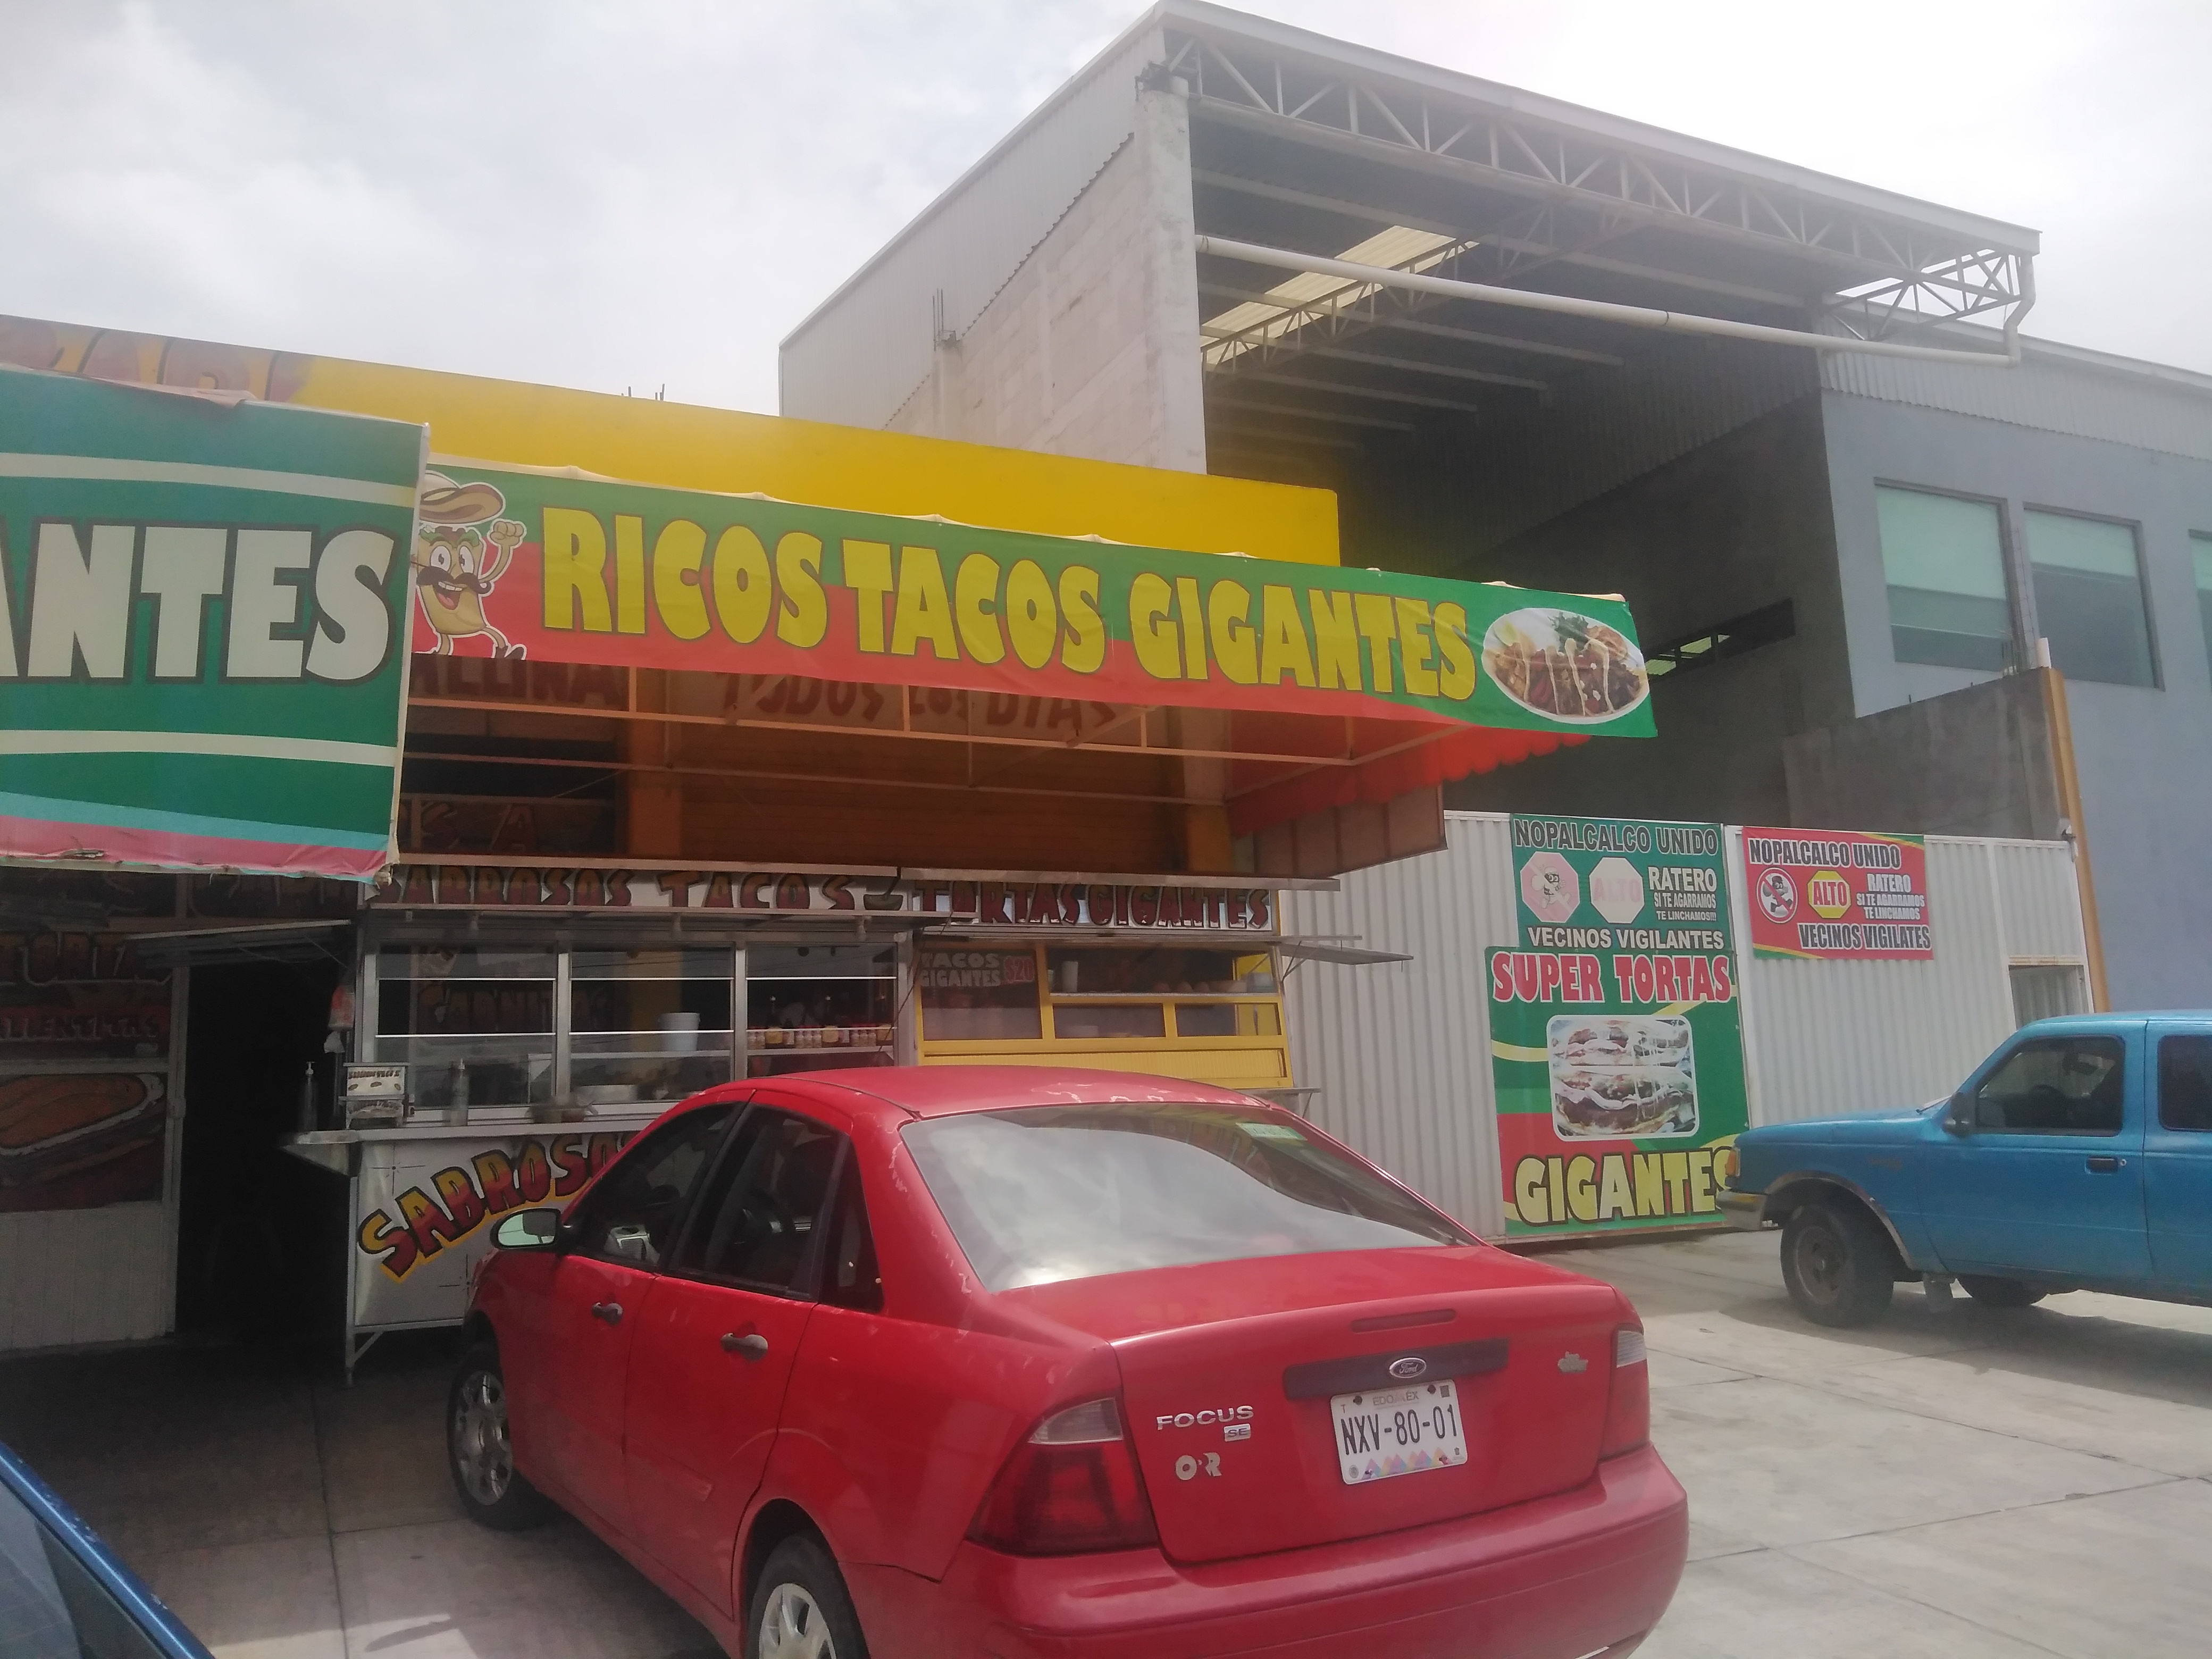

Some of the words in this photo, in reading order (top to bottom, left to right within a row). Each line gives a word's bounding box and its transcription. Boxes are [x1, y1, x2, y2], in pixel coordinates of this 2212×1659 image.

[542, 507, 828, 648] RICOS
[841, 538, 1107, 675] TACOS
[1129, 572, 1477, 701] GIGANTES
[1513, 819, 1650, 853] NOPALCALCO
[1656, 827, 1719, 856] UNIDO
[1748, 838, 1851, 868] NOPALCALCO
[1851, 842, 1902, 869] UNIDO
[656, 870, 856, 910] TACOS
[1648, 867, 1717, 892] RATERO
[1866, 873, 1912, 893] RATERO
[915, 880, 1080, 925] TORTAS
[1087, 885, 1269, 929] GIGANTES
[1654, 892, 1661, 908] SI
[1663, 893, 1672, 908] TE
[1674, 893, 1716, 909] AGARRAMOS
[1813, 881, 1848, 907] ALTO
[1856, 893, 1865, 906] SI
[1866, 893, 1876, 906] TE
[1877, 894, 1925, 908] AGARRAMOS
[1656, 911, 1667, 920] TE
[1668, 911, 1717, 921] LINCHAMOS!!!
[1864, 907, 1875, 919] TE
[1875, 907, 1921, 920] LINCHAMOS
[1528, 927, 1612, 948] VECINOS
[1616, 929, 1724, 949] VIGILANTES
[1798, 923, 1862, 950] VECINOS
[1863, 924, 1932, 950] VIGILATES
[921, 952, 1000, 969] TACOS
[920, 969, 1001, 987] GIGANTES
[1491, 952, 1605, 1003] SUPER
[1613, 954, 1731, 1003] TORTAS
[1399, 1362, 1419, 1374] Ford
[1157, 1405, 1254, 1430] FOCUS
[1340, 1403, 1457, 1455] NXV-80-01
[1228, 1428, 1248, 1438] SE
